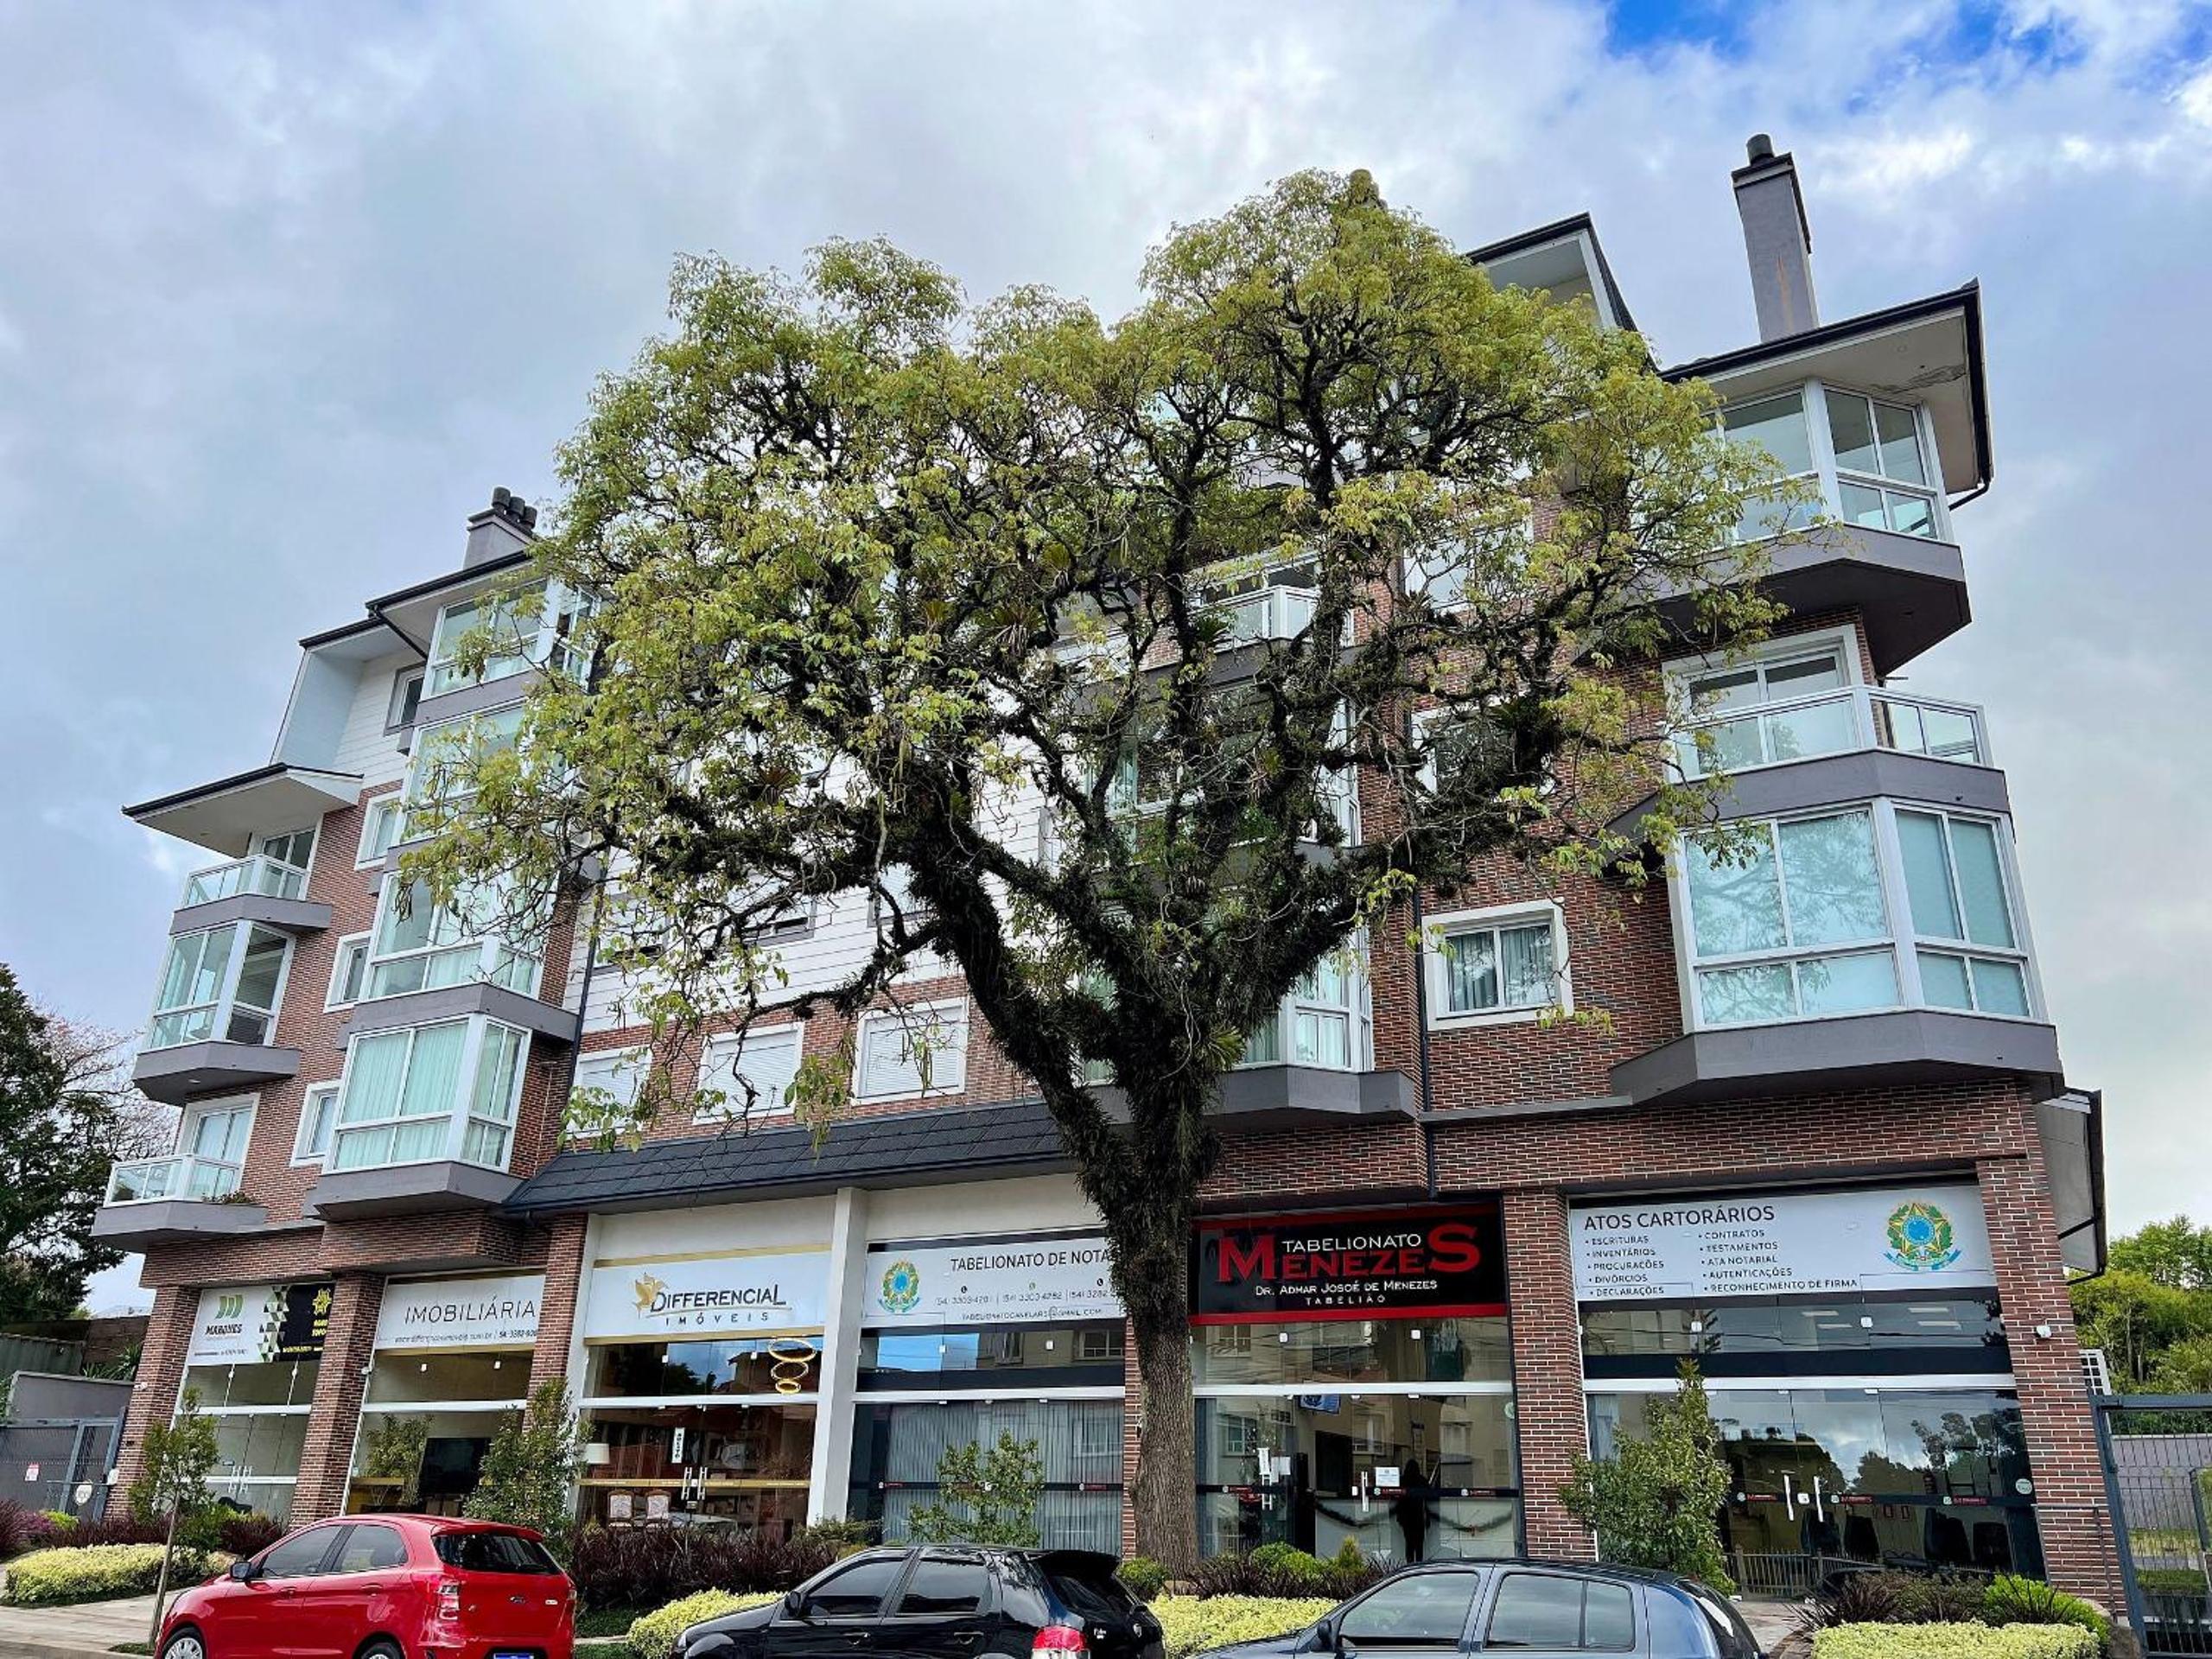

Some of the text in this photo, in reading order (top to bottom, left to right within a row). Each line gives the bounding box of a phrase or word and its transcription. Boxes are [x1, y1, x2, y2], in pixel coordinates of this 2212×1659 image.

[1585, 1205, 1775, 1230] ATOS CARTORÁRIOS
[1592, 1236, 1649, 1245] ESCRITURAS
[1705, 1230, 1764, 1240] CONTRATOS
[1281, 1234, 1421, 1253] TABELIONATO
[1706, 1242, 1778, 1253] TESTAMENTOS
[1217, 1224, 1480, 1282] MENEZES
[1592, 1248, 1656, 1257] INVENTÁRIOS
[950, 1249, 1111, 1271] TABELIONATO DE NOTA
[1593, 1260, 1664, 1271] PROCURAÇÕES
[1707, 1255, 1777, 1266] ATA NOTARIAL
[1595, 1274, 1648, 1284] DIVÓRCIOS
[1709, 1268, 1792, 1279] AUTENTICAÇÕES
[1255, 1285, 1274, 1295] DR.
[1363, 1282, 1380, 1292] DE
[1383, 1280, 1438, 1292] MENEZES
[1596, 1286, 1664, 1297] DECLARAÇÕES
[1711, 1279, 1858, 1293] RECONHECIMENTO DE FIRMA
[651, 1284, 786, 1313] DIFFERENCIAL
[404, 1295, 536, 1324] IMOBILIÁRIA
[666, 1313, 768, 1325] IMÓVEIS
